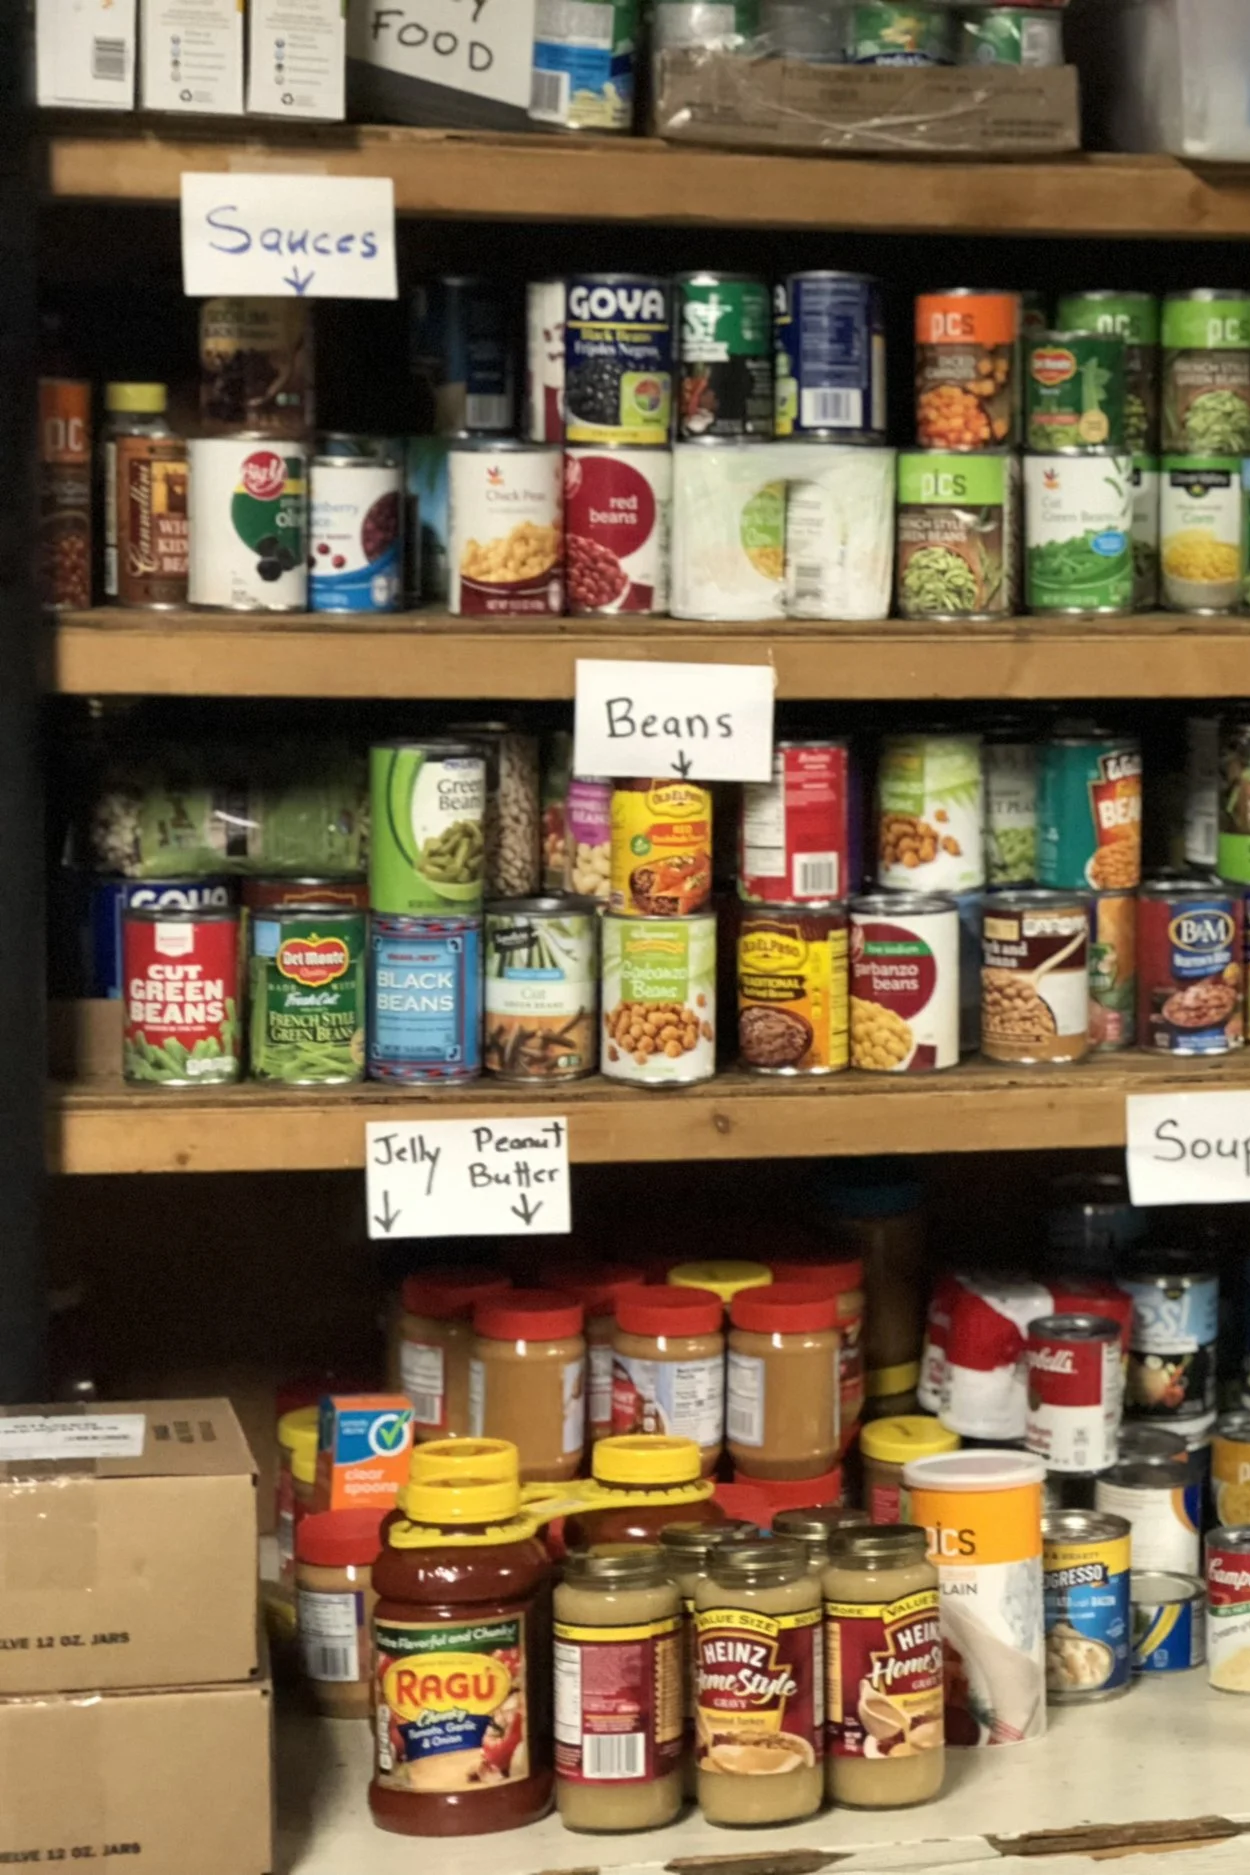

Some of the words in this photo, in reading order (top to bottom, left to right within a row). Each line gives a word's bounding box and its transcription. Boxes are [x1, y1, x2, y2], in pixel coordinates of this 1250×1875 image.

[371, 10, 493, 71] FOOD
[205, 205, 378, 257] Sauces
[568, 285, 666, 321] GOYA
[609, 496, 638, 510] red
[589, 508, 638, 525] beans
[605, 696, 733, 739] Beans
[282, 950, 303, 966] Del
[303, 950, 346, 966] Monte
[147, 965, 203, 980] CUT
[377, 969, 454, 989] BLACK
[854, 962, 919, 979] garbanzo
[130, 979, 223, 1001] GREEN
[872, 976, 919, 990] beans
[130, 1001, 224, 1024] BEANS
[377, 994, 454, 1013] BEANS
[269, 1011, 320, 1028] FRENCH
[270, 1027, 315, 1043] GREEN
[472, 1121, 565, 1152] Peanut
[374, 1133, 441, 1196] Jelly
[468, 1161, 559, 1188] Butter
[344, 1468, 385, 1481] clear
[343, 1480, 400, 1498] spoons
[940, 1582, 977, 1596] LAIN
[887, 1595, 930, 1617] VALUE
[738, 1613, 776, 1633] SIZE
[36, 1636, 56, 1650] 12
[60, 1634, 86, 1649] OZ.
[90, 1631, 131, 1647] JARS
[448, 1630, 473, 1643] and
[703, 1640, 768, 1668] HEINZ
[713, 1698, 748, 1710] GRAVY
[46, 1847, 65, 1861] 12
[102, 1842, 142, 1857] JARS
